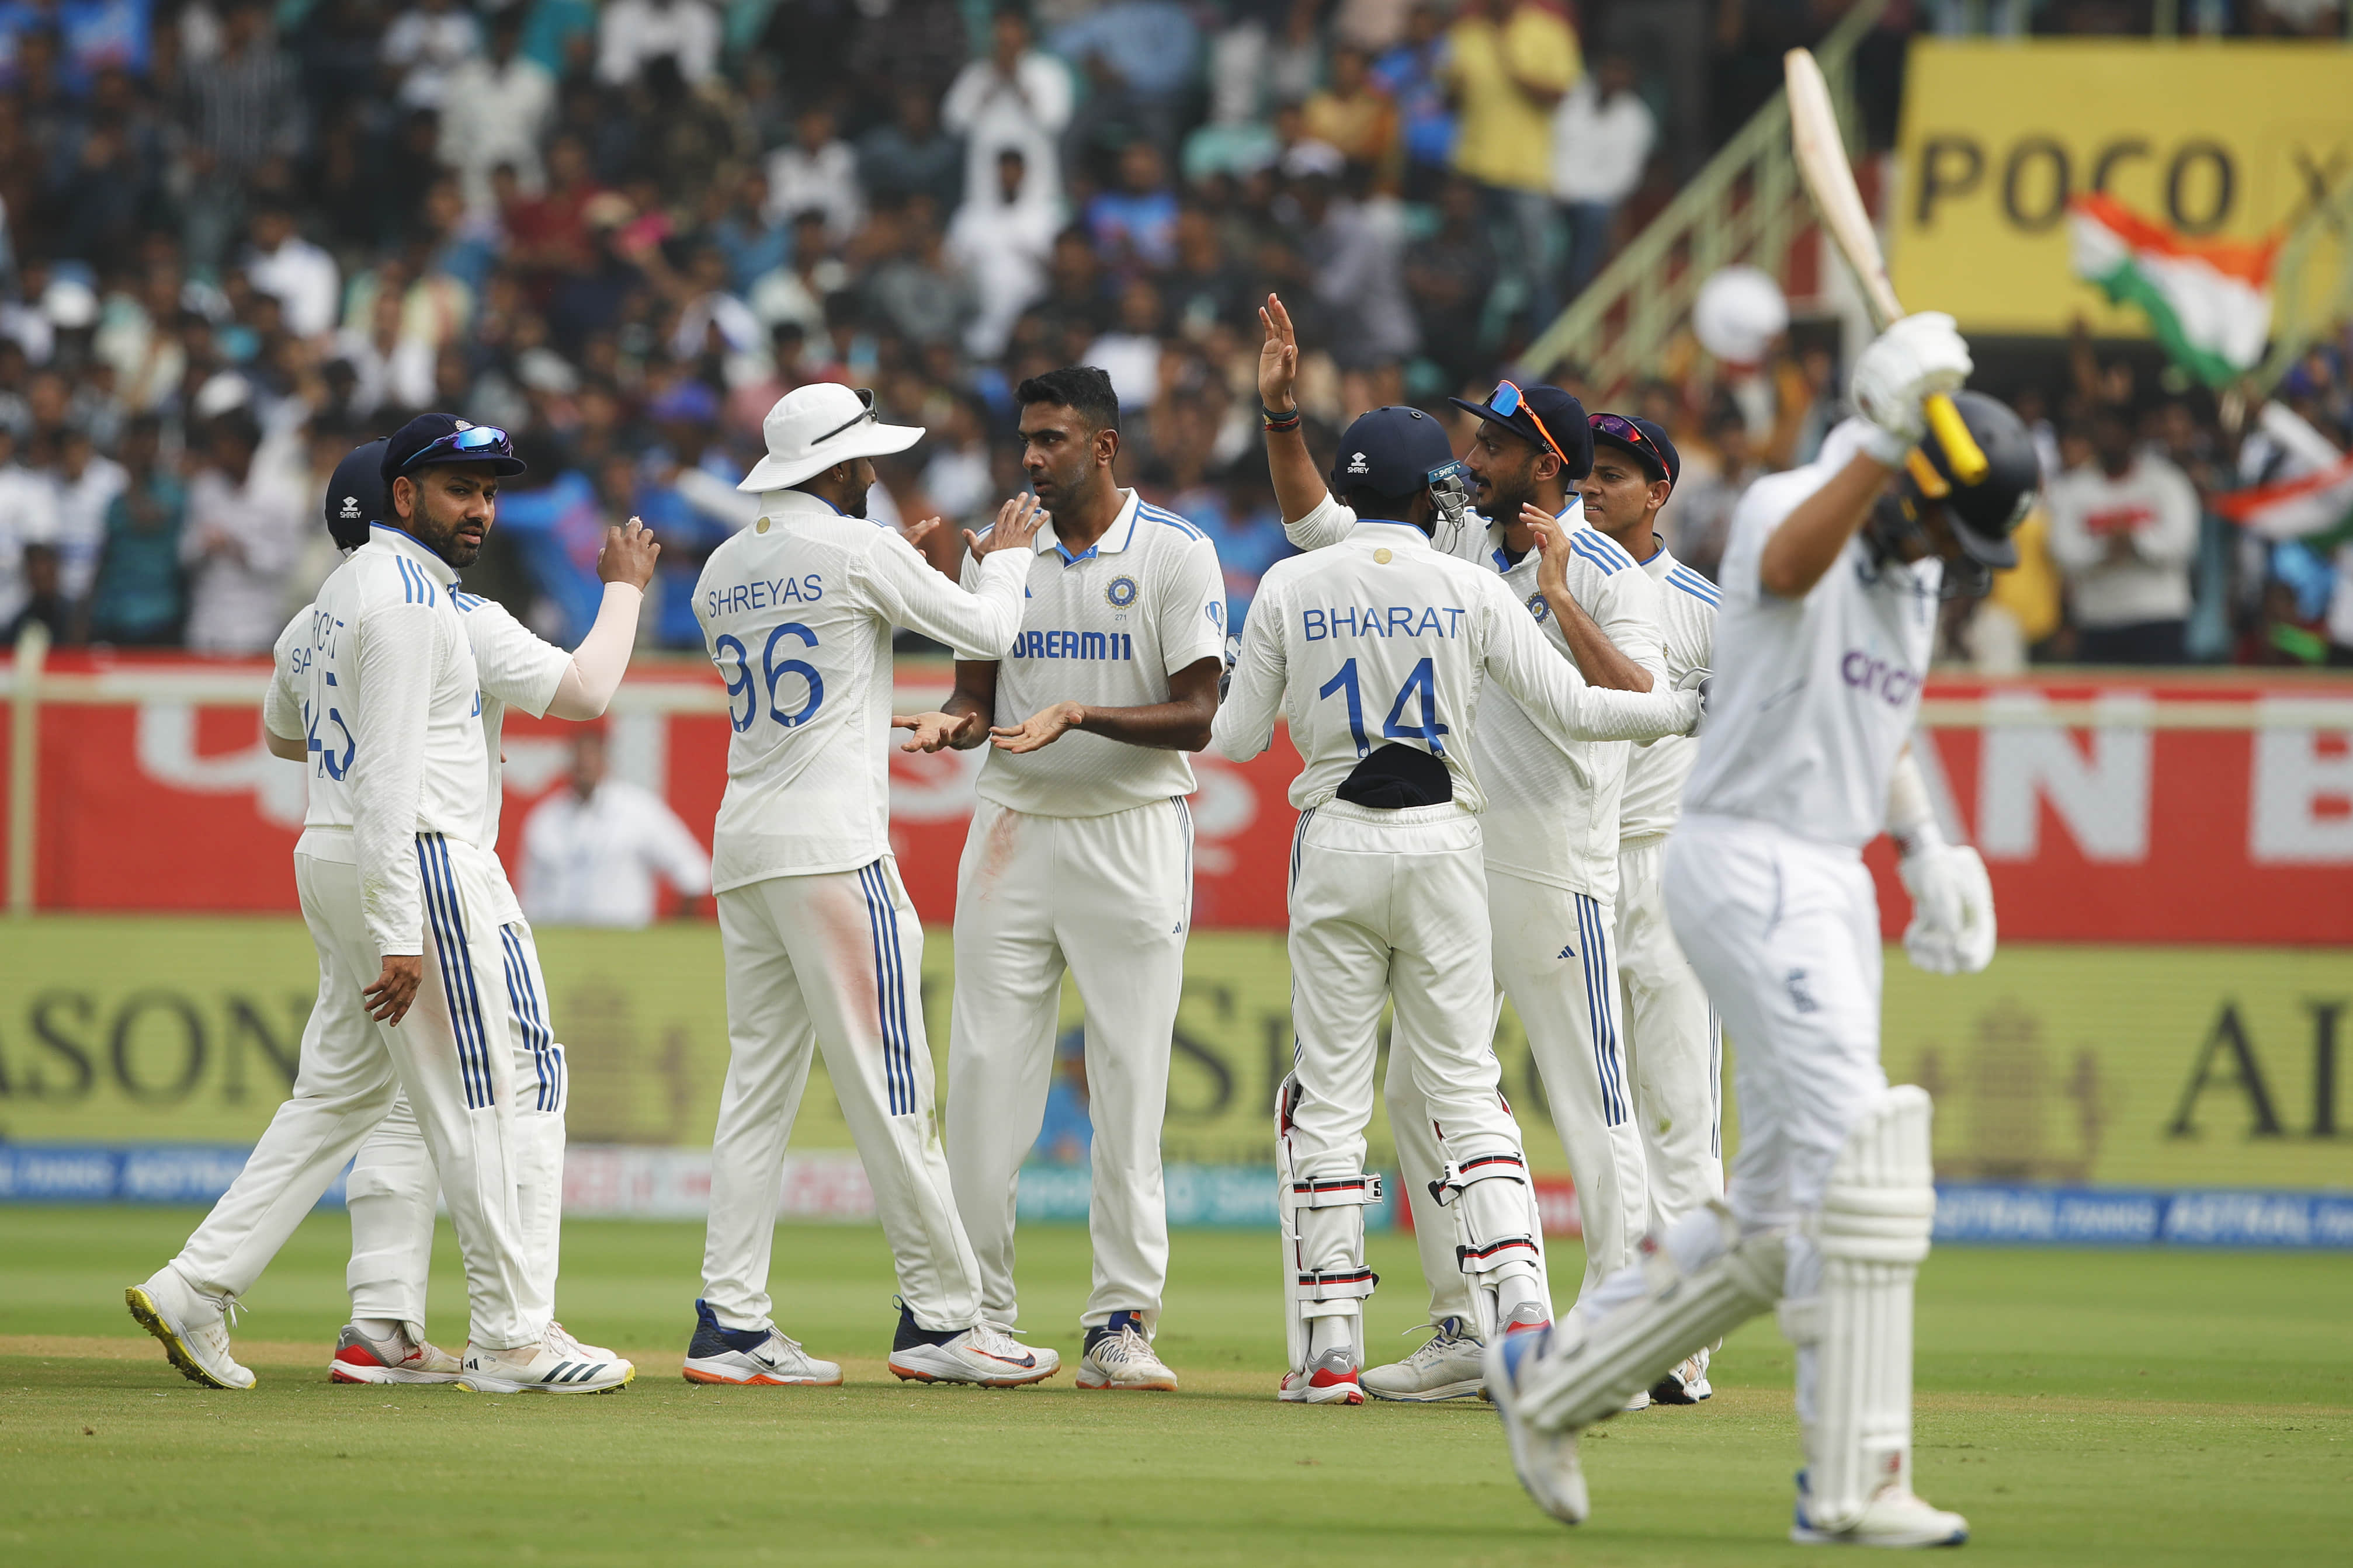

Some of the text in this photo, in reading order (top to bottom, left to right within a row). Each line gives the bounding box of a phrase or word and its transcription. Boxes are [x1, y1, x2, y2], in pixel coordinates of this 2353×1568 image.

[1913, 133, 2239, 235] POCO
[709, 574, 822, 618] SHREYAS
[1303, 606, 1465, 642] BHARAT
[713, 623, 824, 733] 96
[1012, 631, 1131, 661] DREAM11
[1318, 657, 1449, 759] 14
